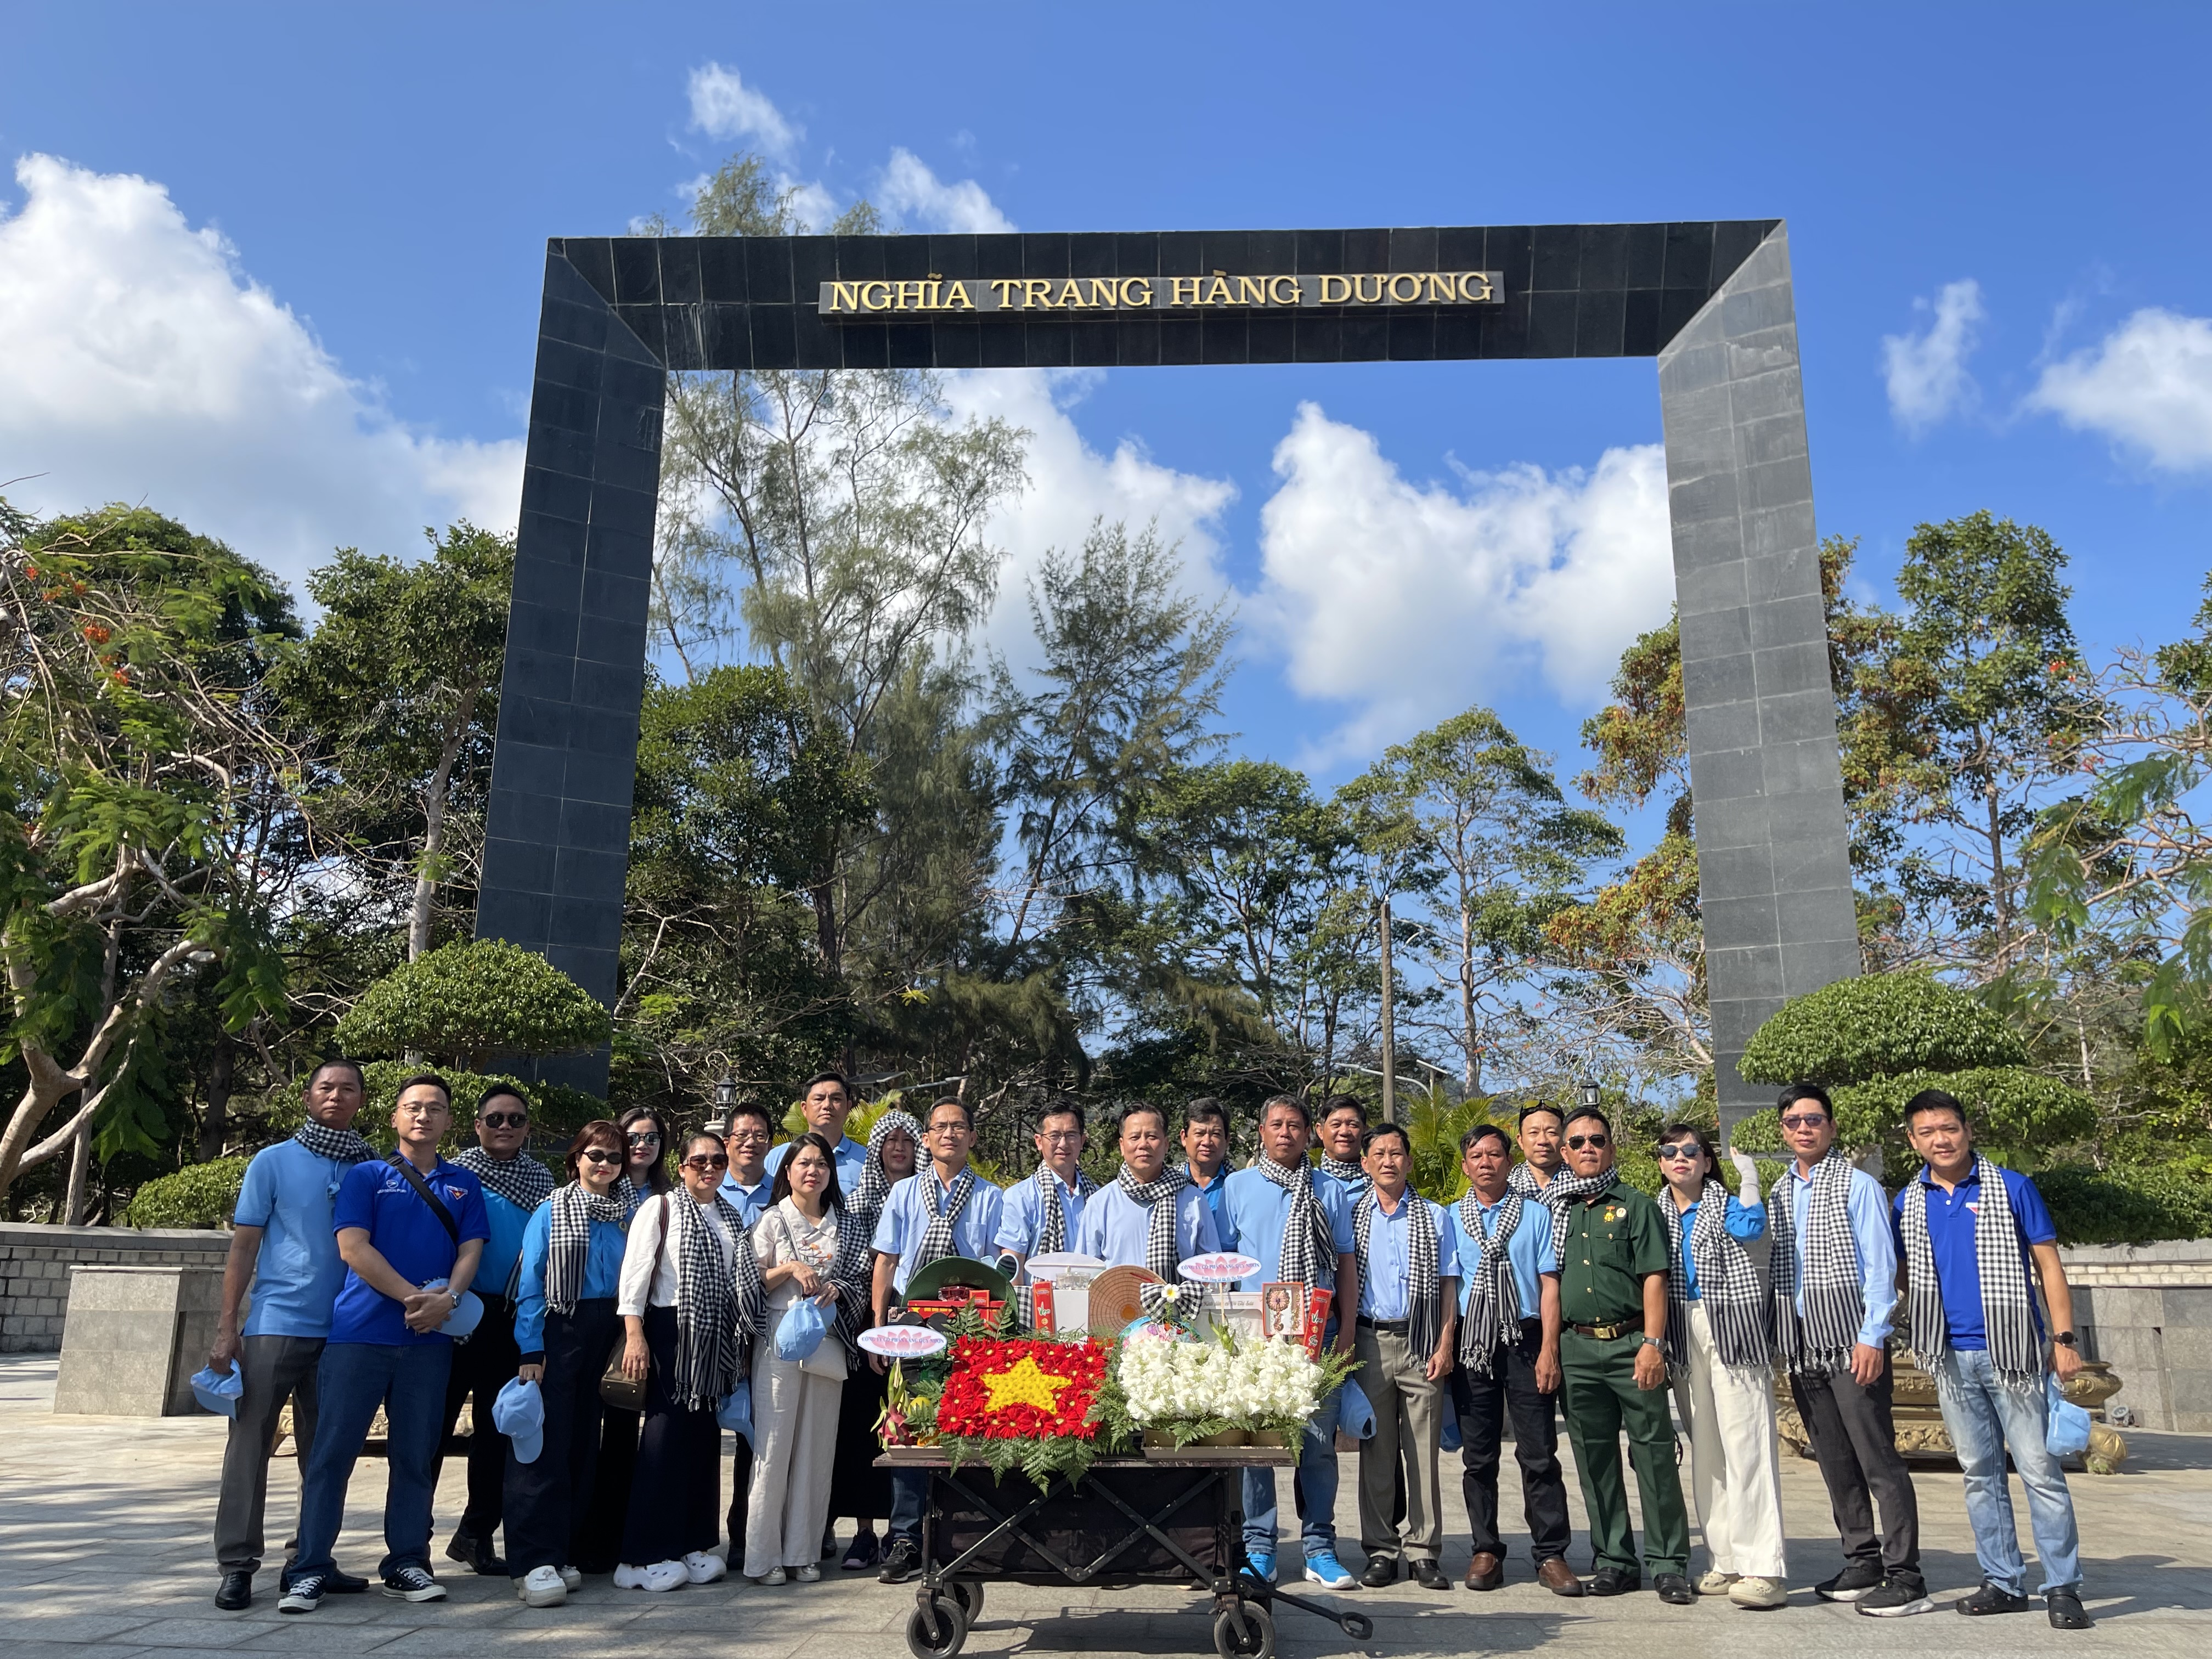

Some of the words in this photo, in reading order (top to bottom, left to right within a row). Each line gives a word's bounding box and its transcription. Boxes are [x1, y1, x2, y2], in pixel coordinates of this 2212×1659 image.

[830, 273, 974, 311] NGHĨA
[991, 278, 1153, 308] TRANG
[1170, 269, 1302, 305] HÀNG
[1319, 272, 1493, 303] DƯƠNG
